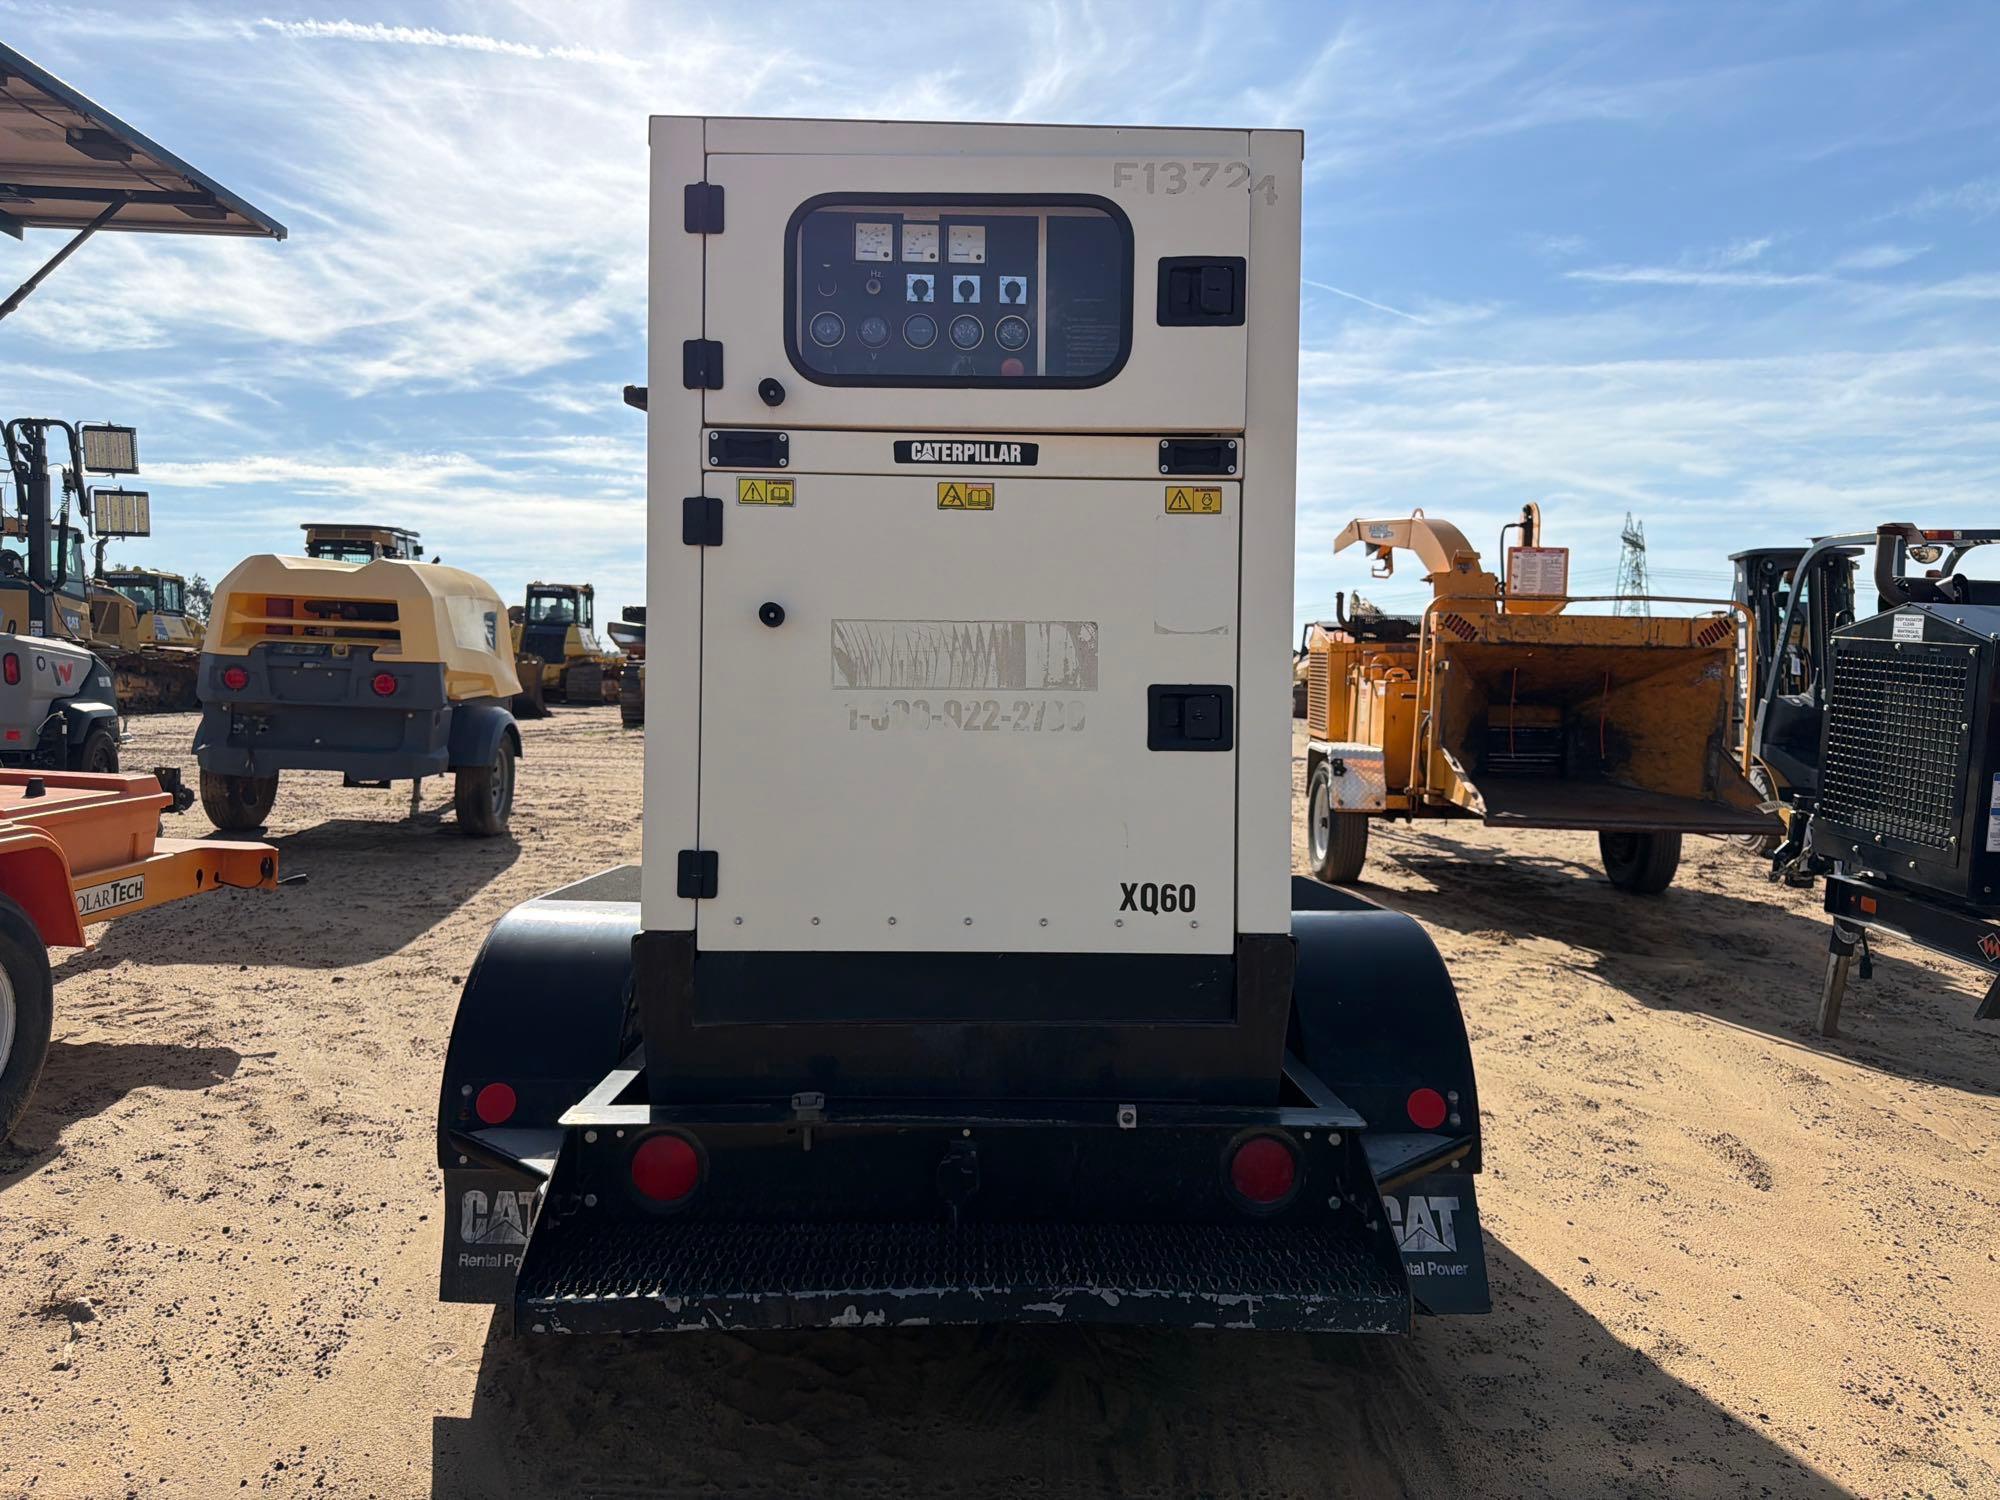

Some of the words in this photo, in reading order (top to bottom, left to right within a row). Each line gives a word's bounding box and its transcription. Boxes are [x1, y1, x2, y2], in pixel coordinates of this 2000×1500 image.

[911, 441, 1022, 463] CATERPILLAR
[76, 881, 143, 912] OLARTECH
[1119, 882, 1196, 916] XQ60
[461, 1190, 539, 1245] CAT
[459, 1253, 501, 1267] Rental
[505, 1254, 522, 1267] Po
[1428, 1261, 1468, 1276] Power
